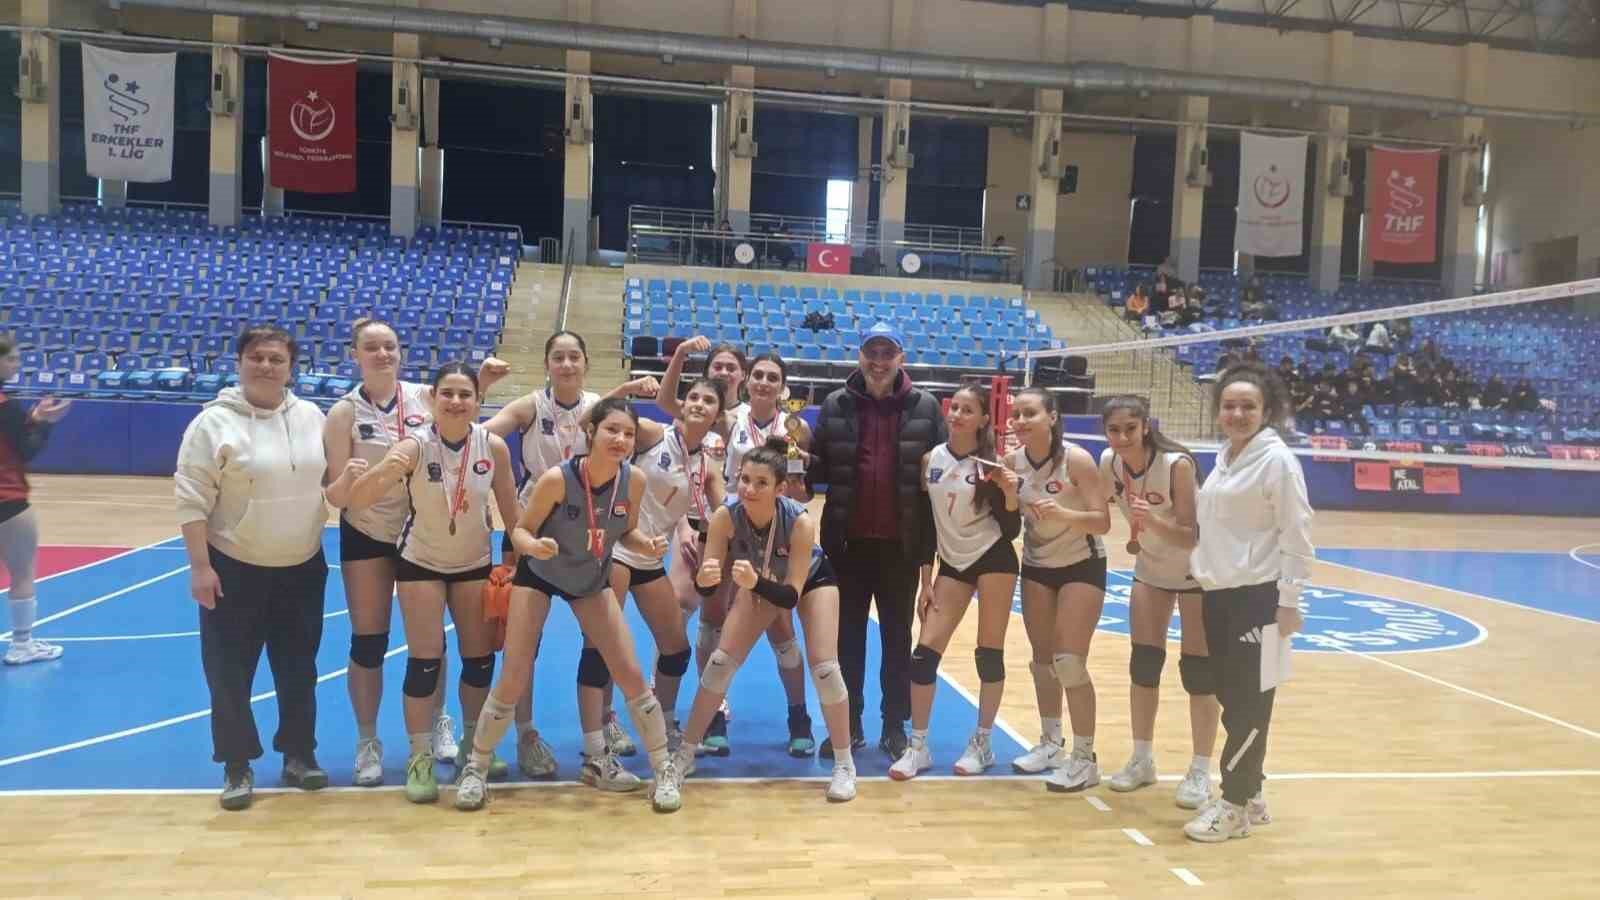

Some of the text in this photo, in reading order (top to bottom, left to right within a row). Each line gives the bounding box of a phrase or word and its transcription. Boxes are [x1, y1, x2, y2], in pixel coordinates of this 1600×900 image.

[113, 123, 141, 135] THF
[91, 132, 164, 148] ERKEKLER
[108, 147, 117, 157] 1.
[1383, 213, 1424, 232] THF
[947, 492, 957, 517] 7
